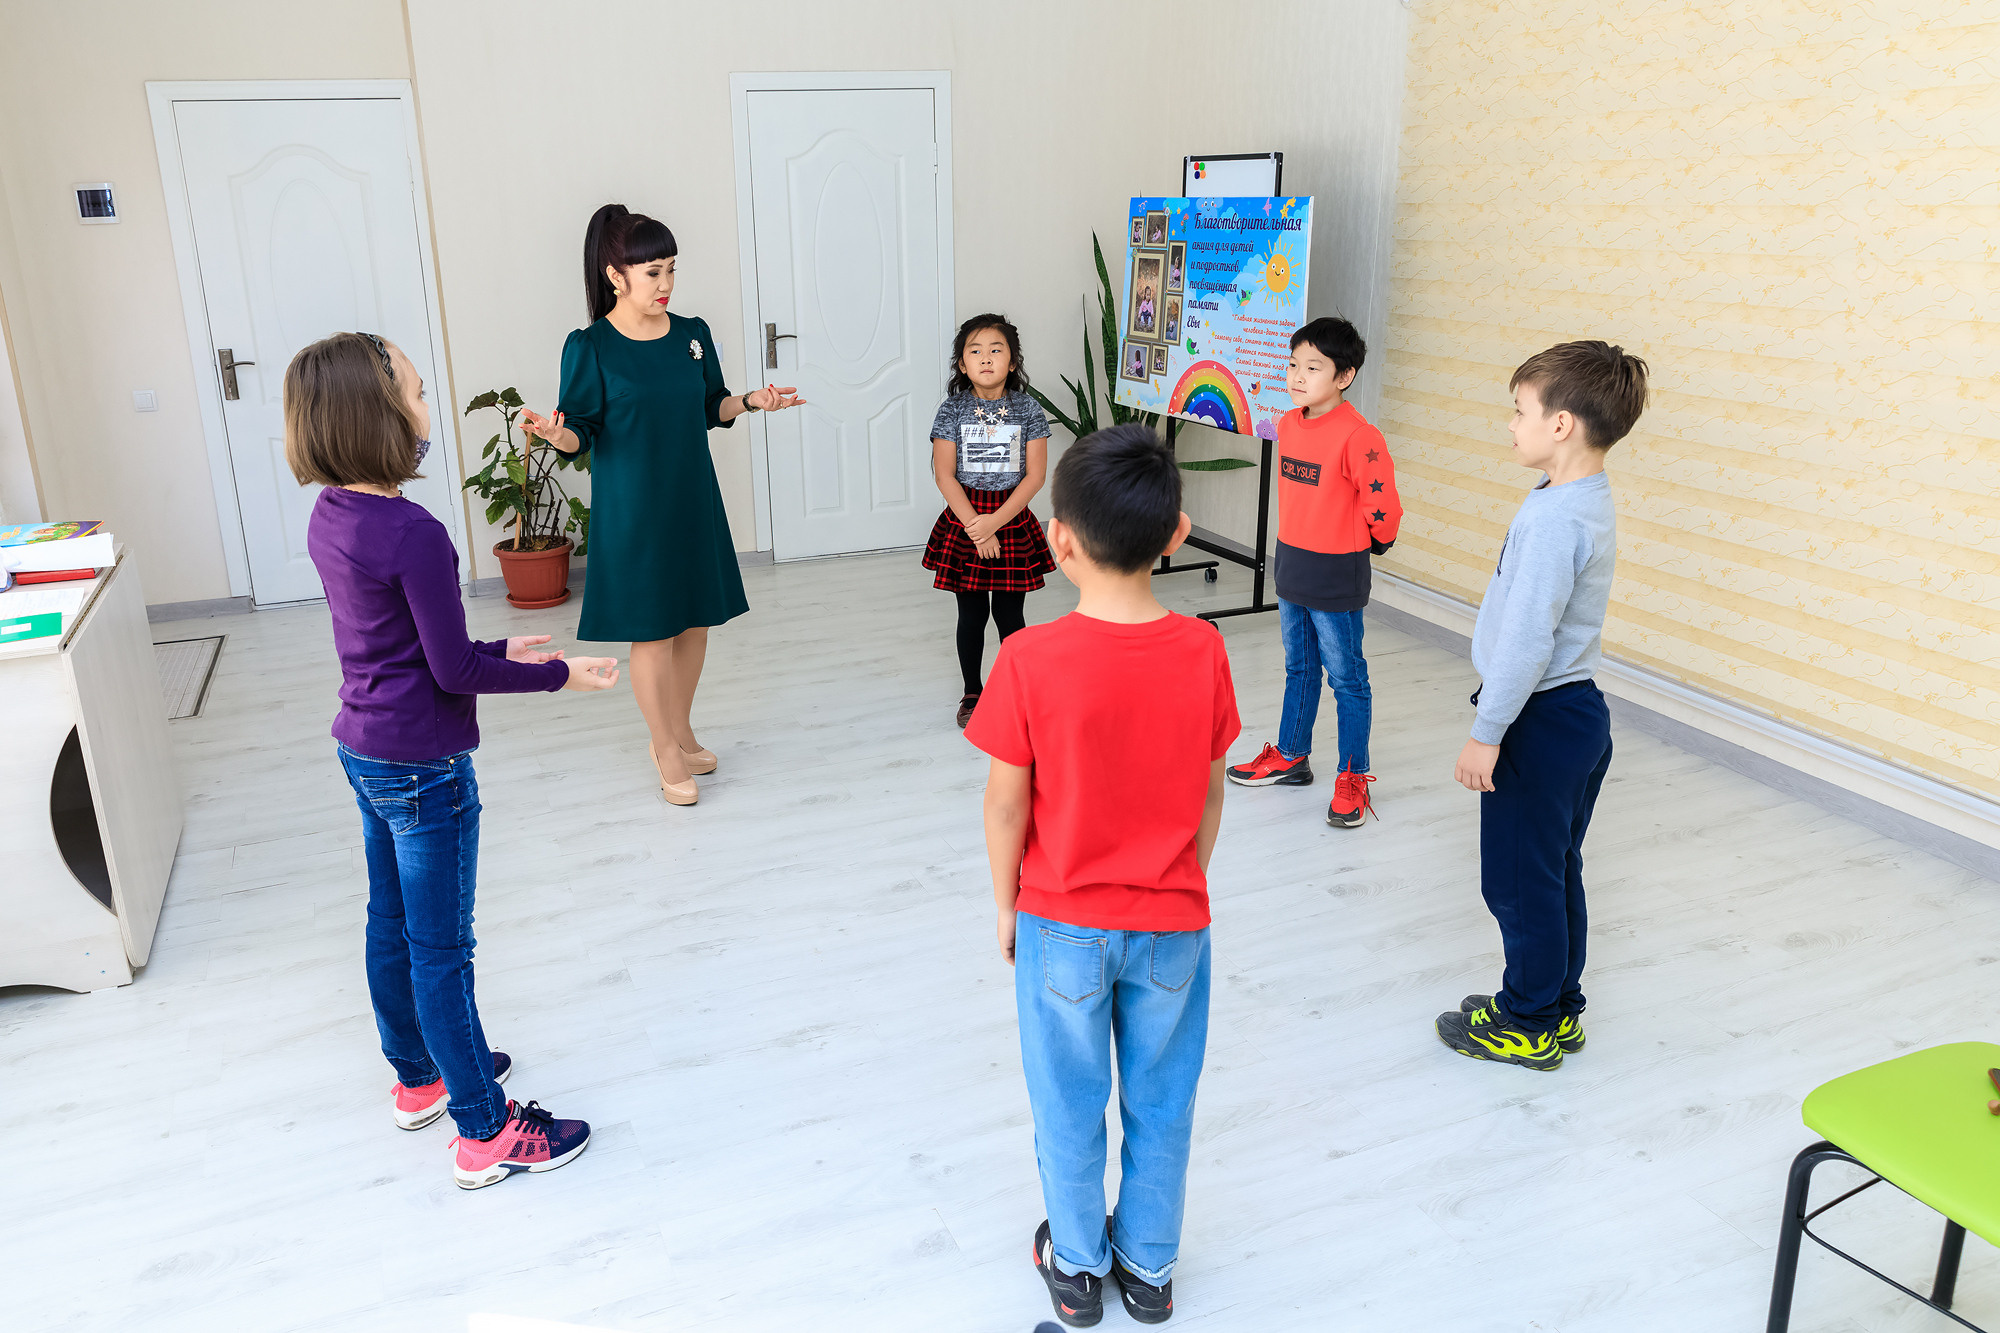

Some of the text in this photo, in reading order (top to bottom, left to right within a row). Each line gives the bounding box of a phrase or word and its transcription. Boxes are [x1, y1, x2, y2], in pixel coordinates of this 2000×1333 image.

[1194, 212, 1302, 235] Благотворительная
[1192, 240, 1254, 255] акция для детей
[1190, 260, 1240, 274] и подростков,
[1189, 277, 1238, 294] посвящённая
[1187, 300, 1219, 311] памяти
[1186, 315, 1200, 328] Евы
